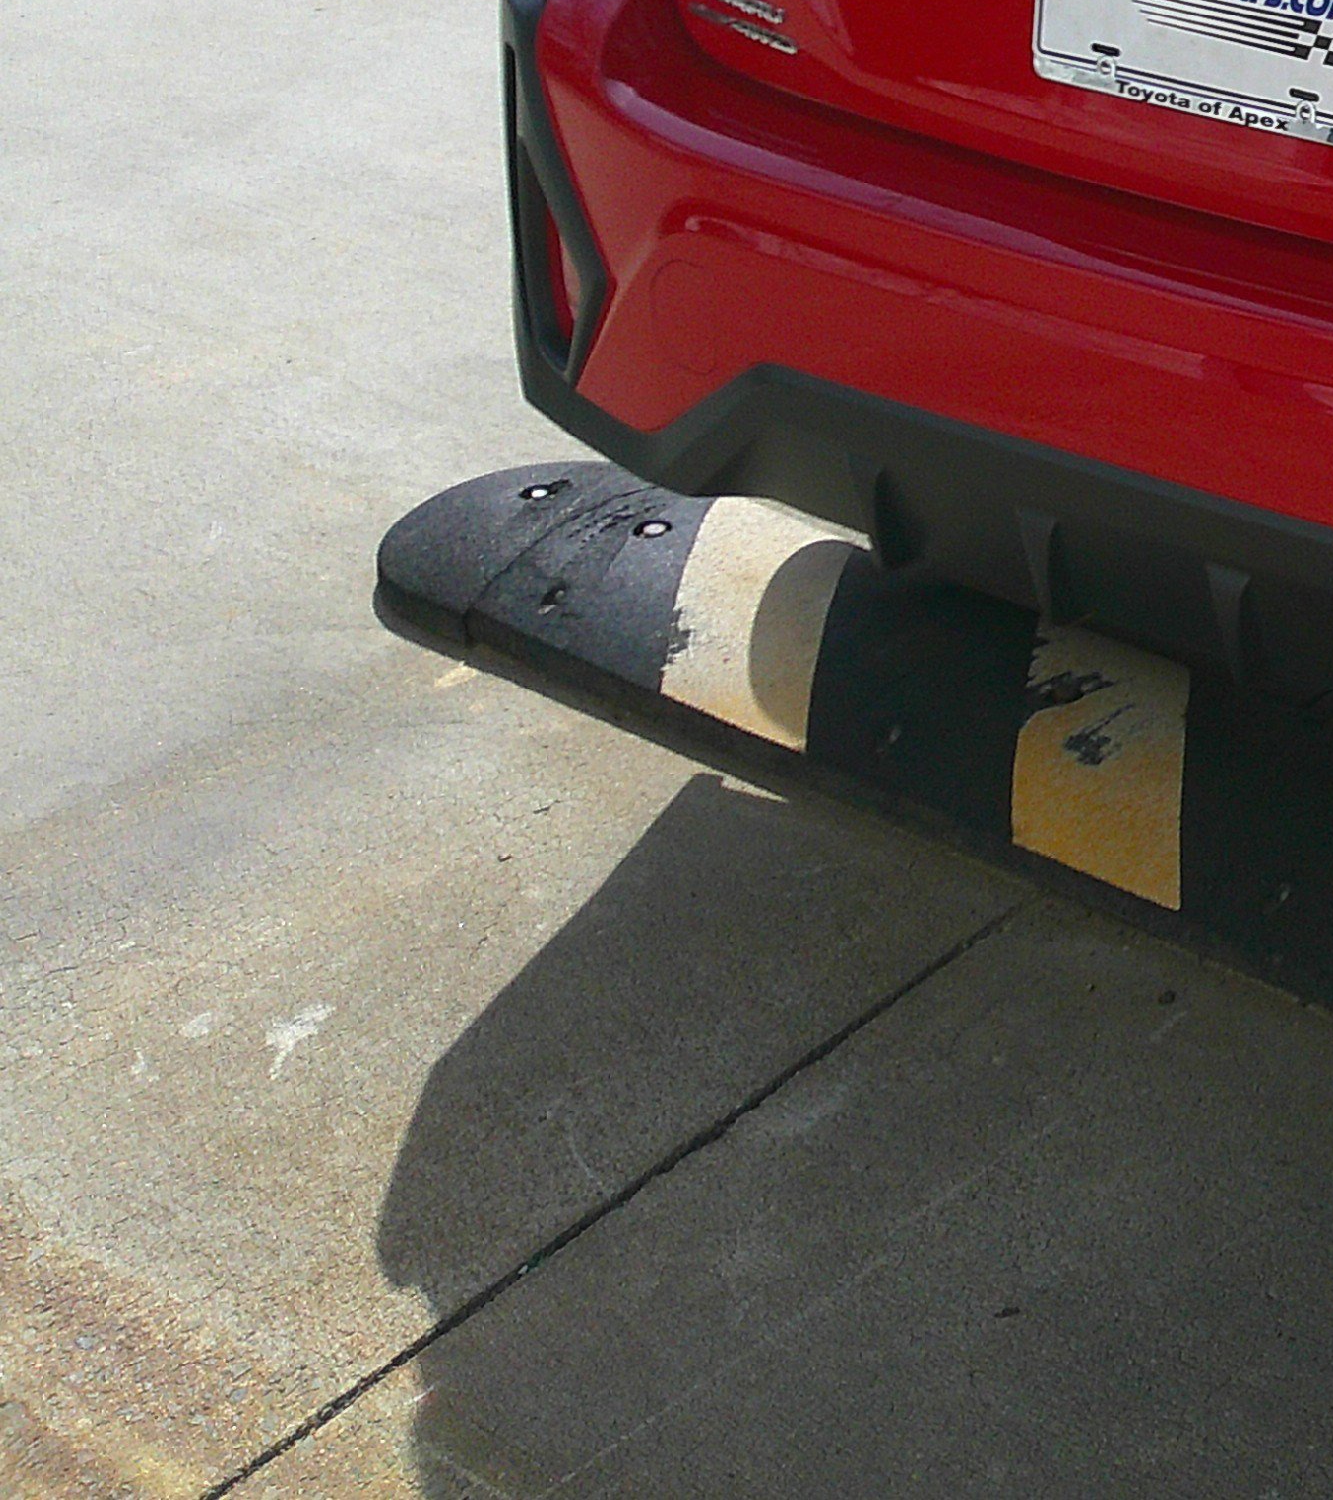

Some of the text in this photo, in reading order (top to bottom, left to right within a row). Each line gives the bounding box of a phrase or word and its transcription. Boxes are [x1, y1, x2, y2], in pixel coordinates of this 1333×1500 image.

[1115, 80, 1289, 131] Toyota of Apex
